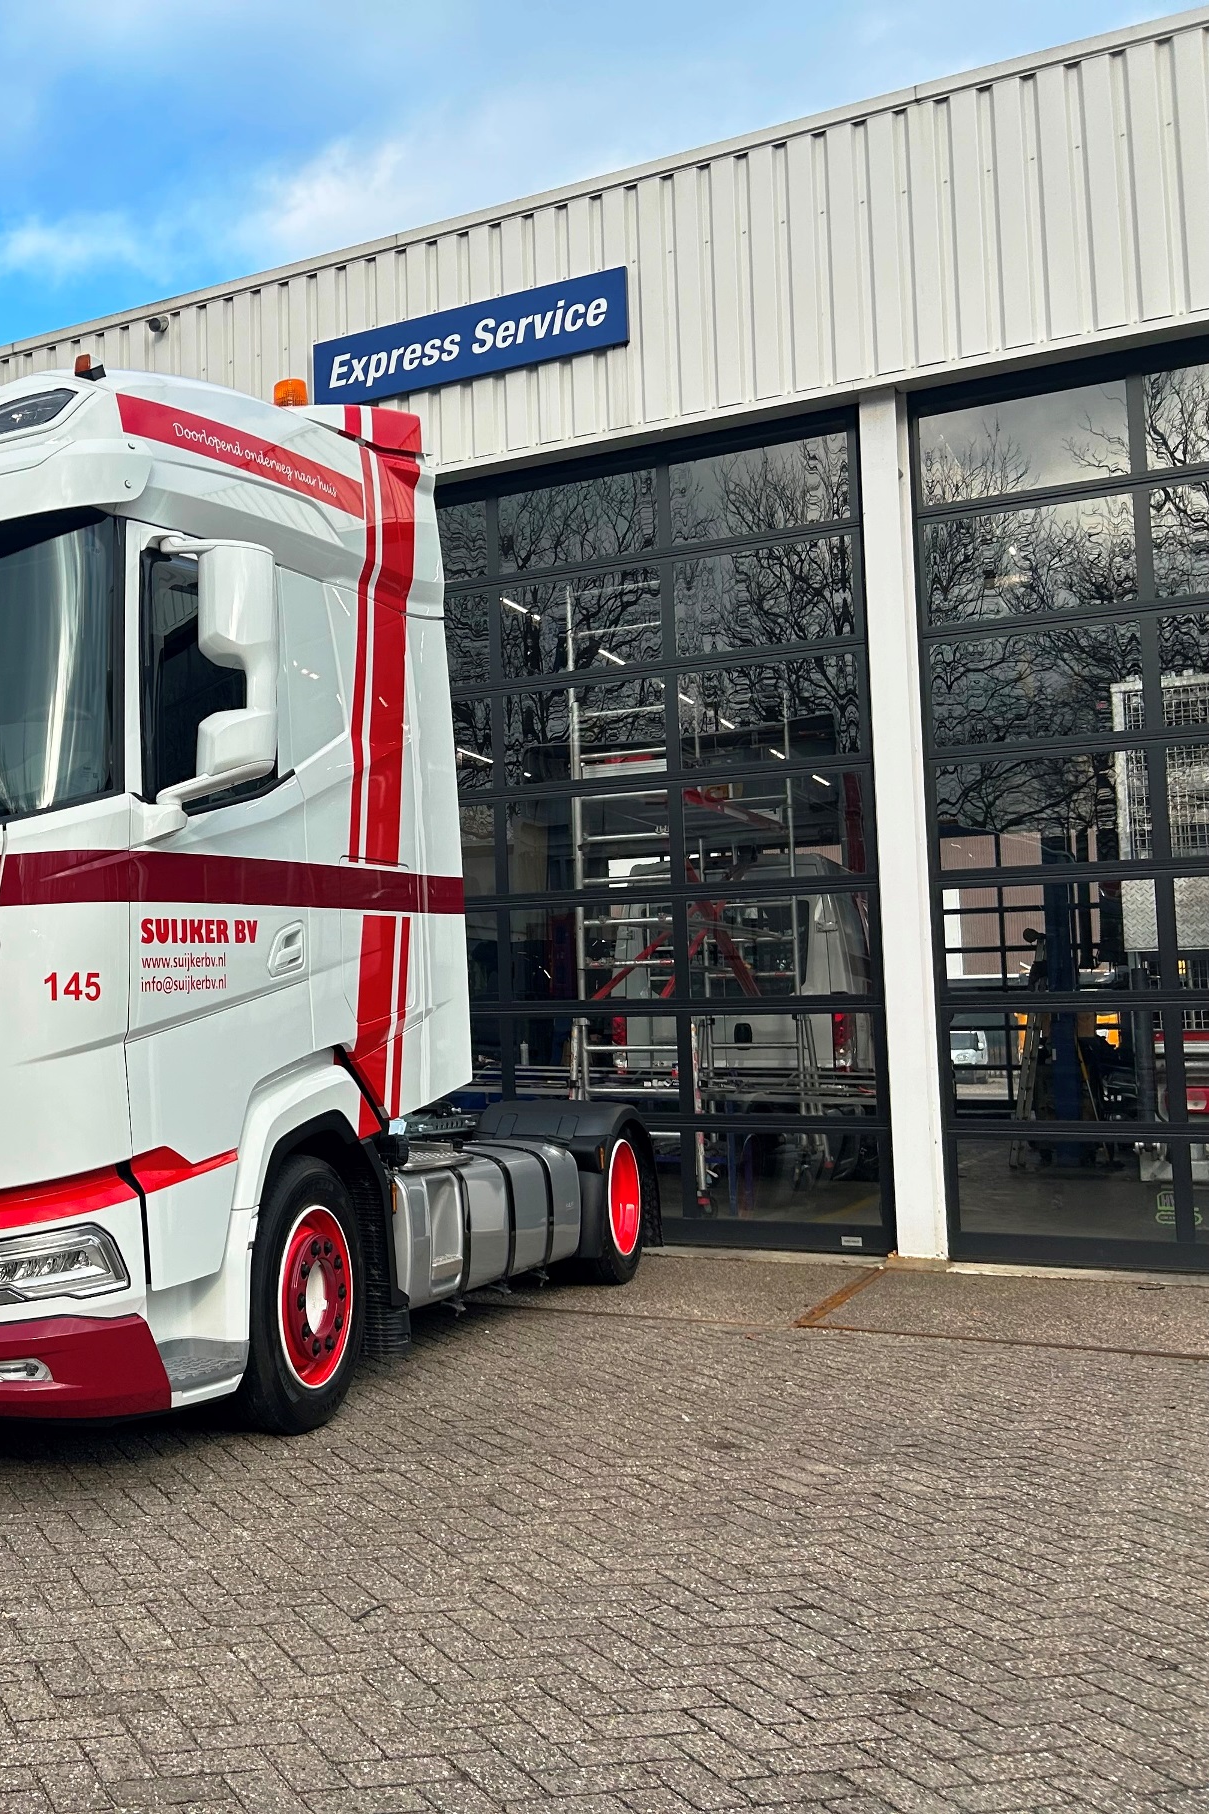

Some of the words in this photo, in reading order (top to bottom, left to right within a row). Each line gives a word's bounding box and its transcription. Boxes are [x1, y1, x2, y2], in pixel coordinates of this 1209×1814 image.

[328, 332, 461, 388] Express
[471, 297, 608, 354] Service
[172, 422, 243, 457] Doorlopend
[244, 449, 293, 481] onderweg
[294, 470, 317, 488] naar
[318, 475, 337, 498] huis
[140, 918, 229, 944] SUIJKER
[234, 919, 258, 944] BV
[141, 952, 227, 971] www.suijkerbv.nl
[44, 972, 101, 1001] 145
[141, 974, 227, 994] info@suijkerbv.nl
